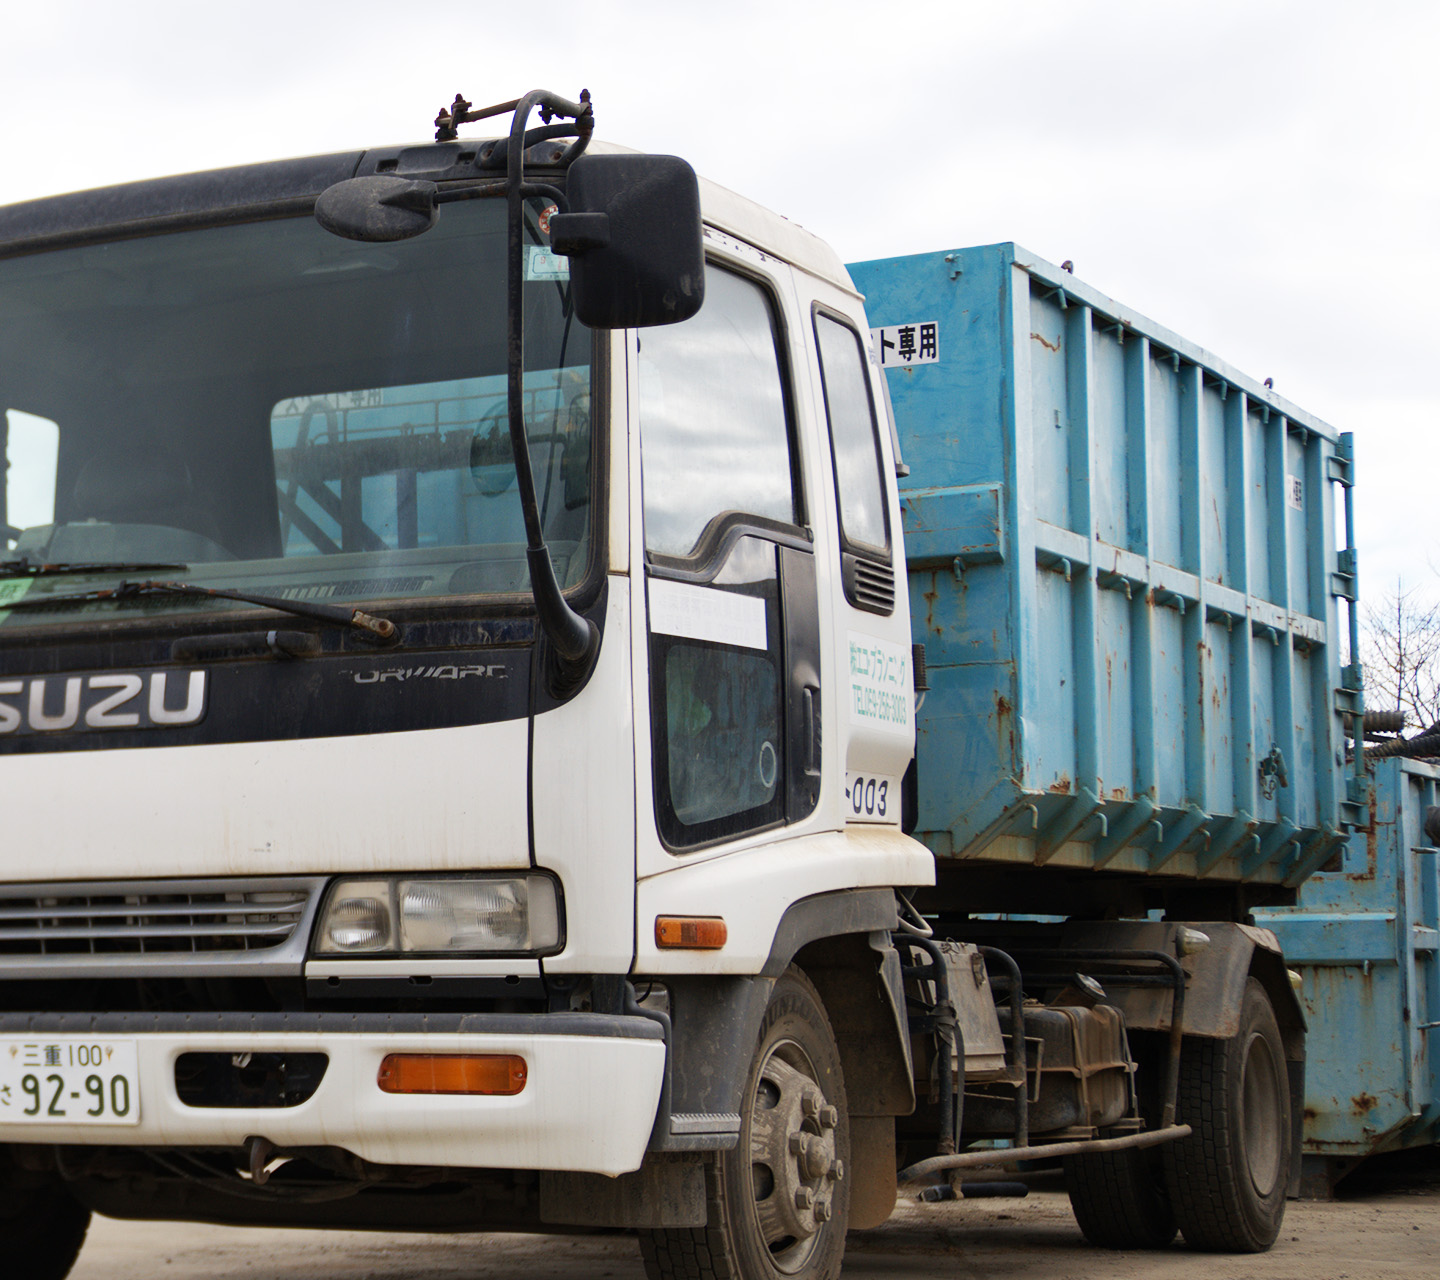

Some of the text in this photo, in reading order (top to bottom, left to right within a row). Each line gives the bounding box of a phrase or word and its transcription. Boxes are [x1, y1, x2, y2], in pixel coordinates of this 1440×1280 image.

[872, 323, 937, 364] ト専用
[21, 1074, 130, 1117] 92-90
